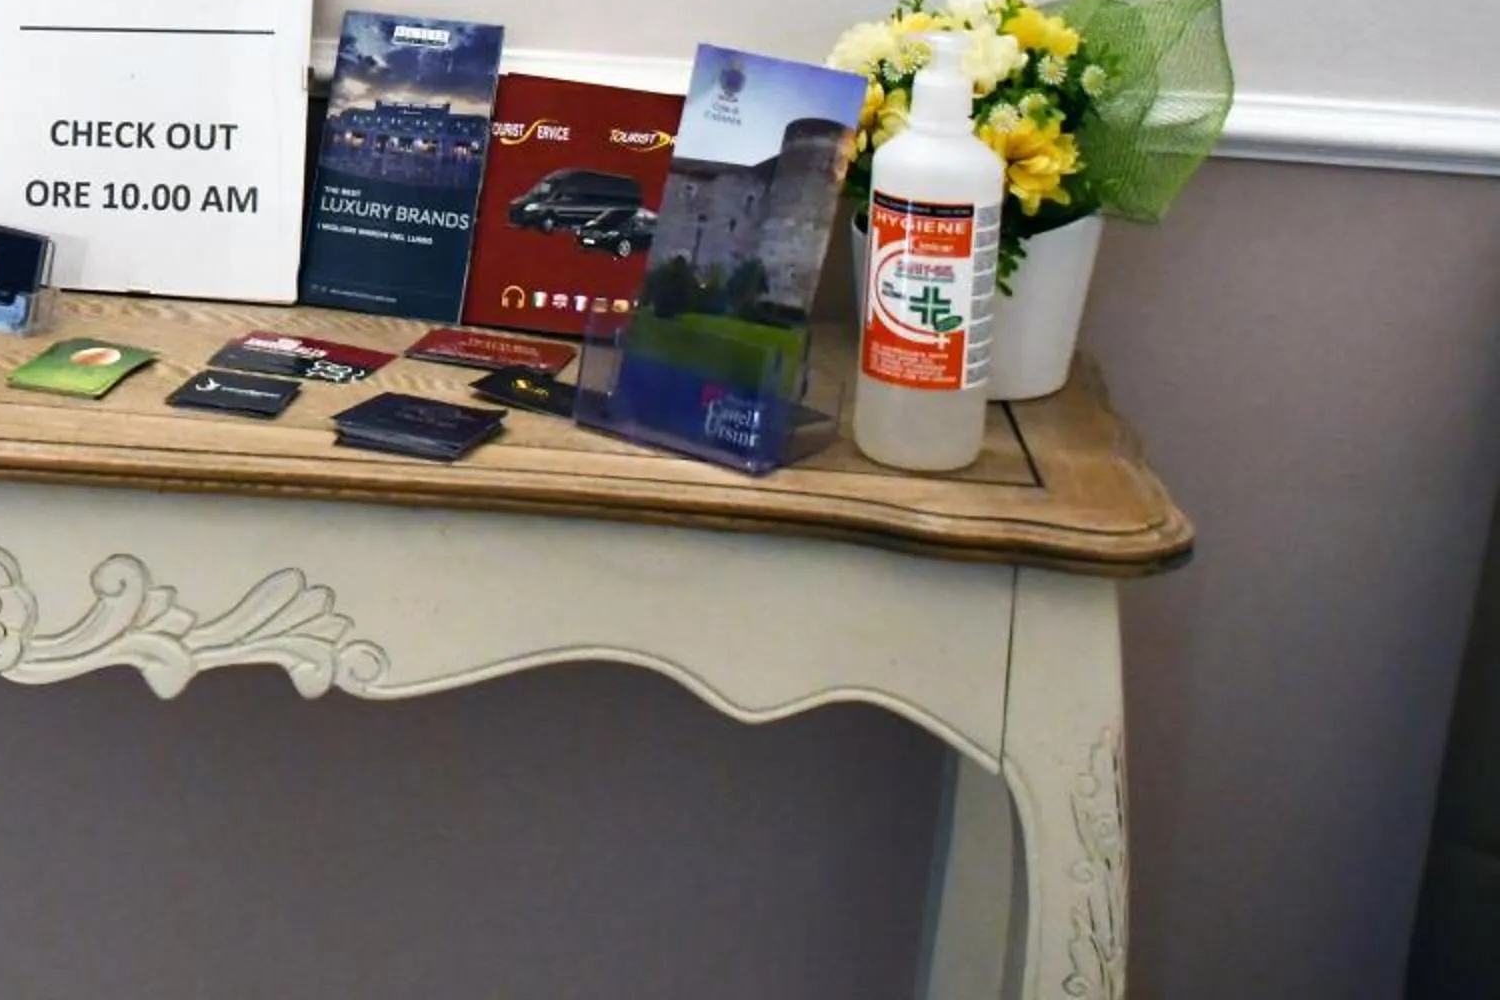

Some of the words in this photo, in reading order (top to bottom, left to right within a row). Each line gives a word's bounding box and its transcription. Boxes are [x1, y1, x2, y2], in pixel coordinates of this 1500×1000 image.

[50, 120, 155, 149] CHECK
[166, 123, 238, 150] OUT
[25, 181, 90, 208] ORE
[102, 183, 191, 211] 10.00
[200, 186, 258, 213] AM
[320, 197, 393, 219] LUXURY
[395, 205, 470, 230] BRANDS
[875, 210, 967, 235] HYGIENE
